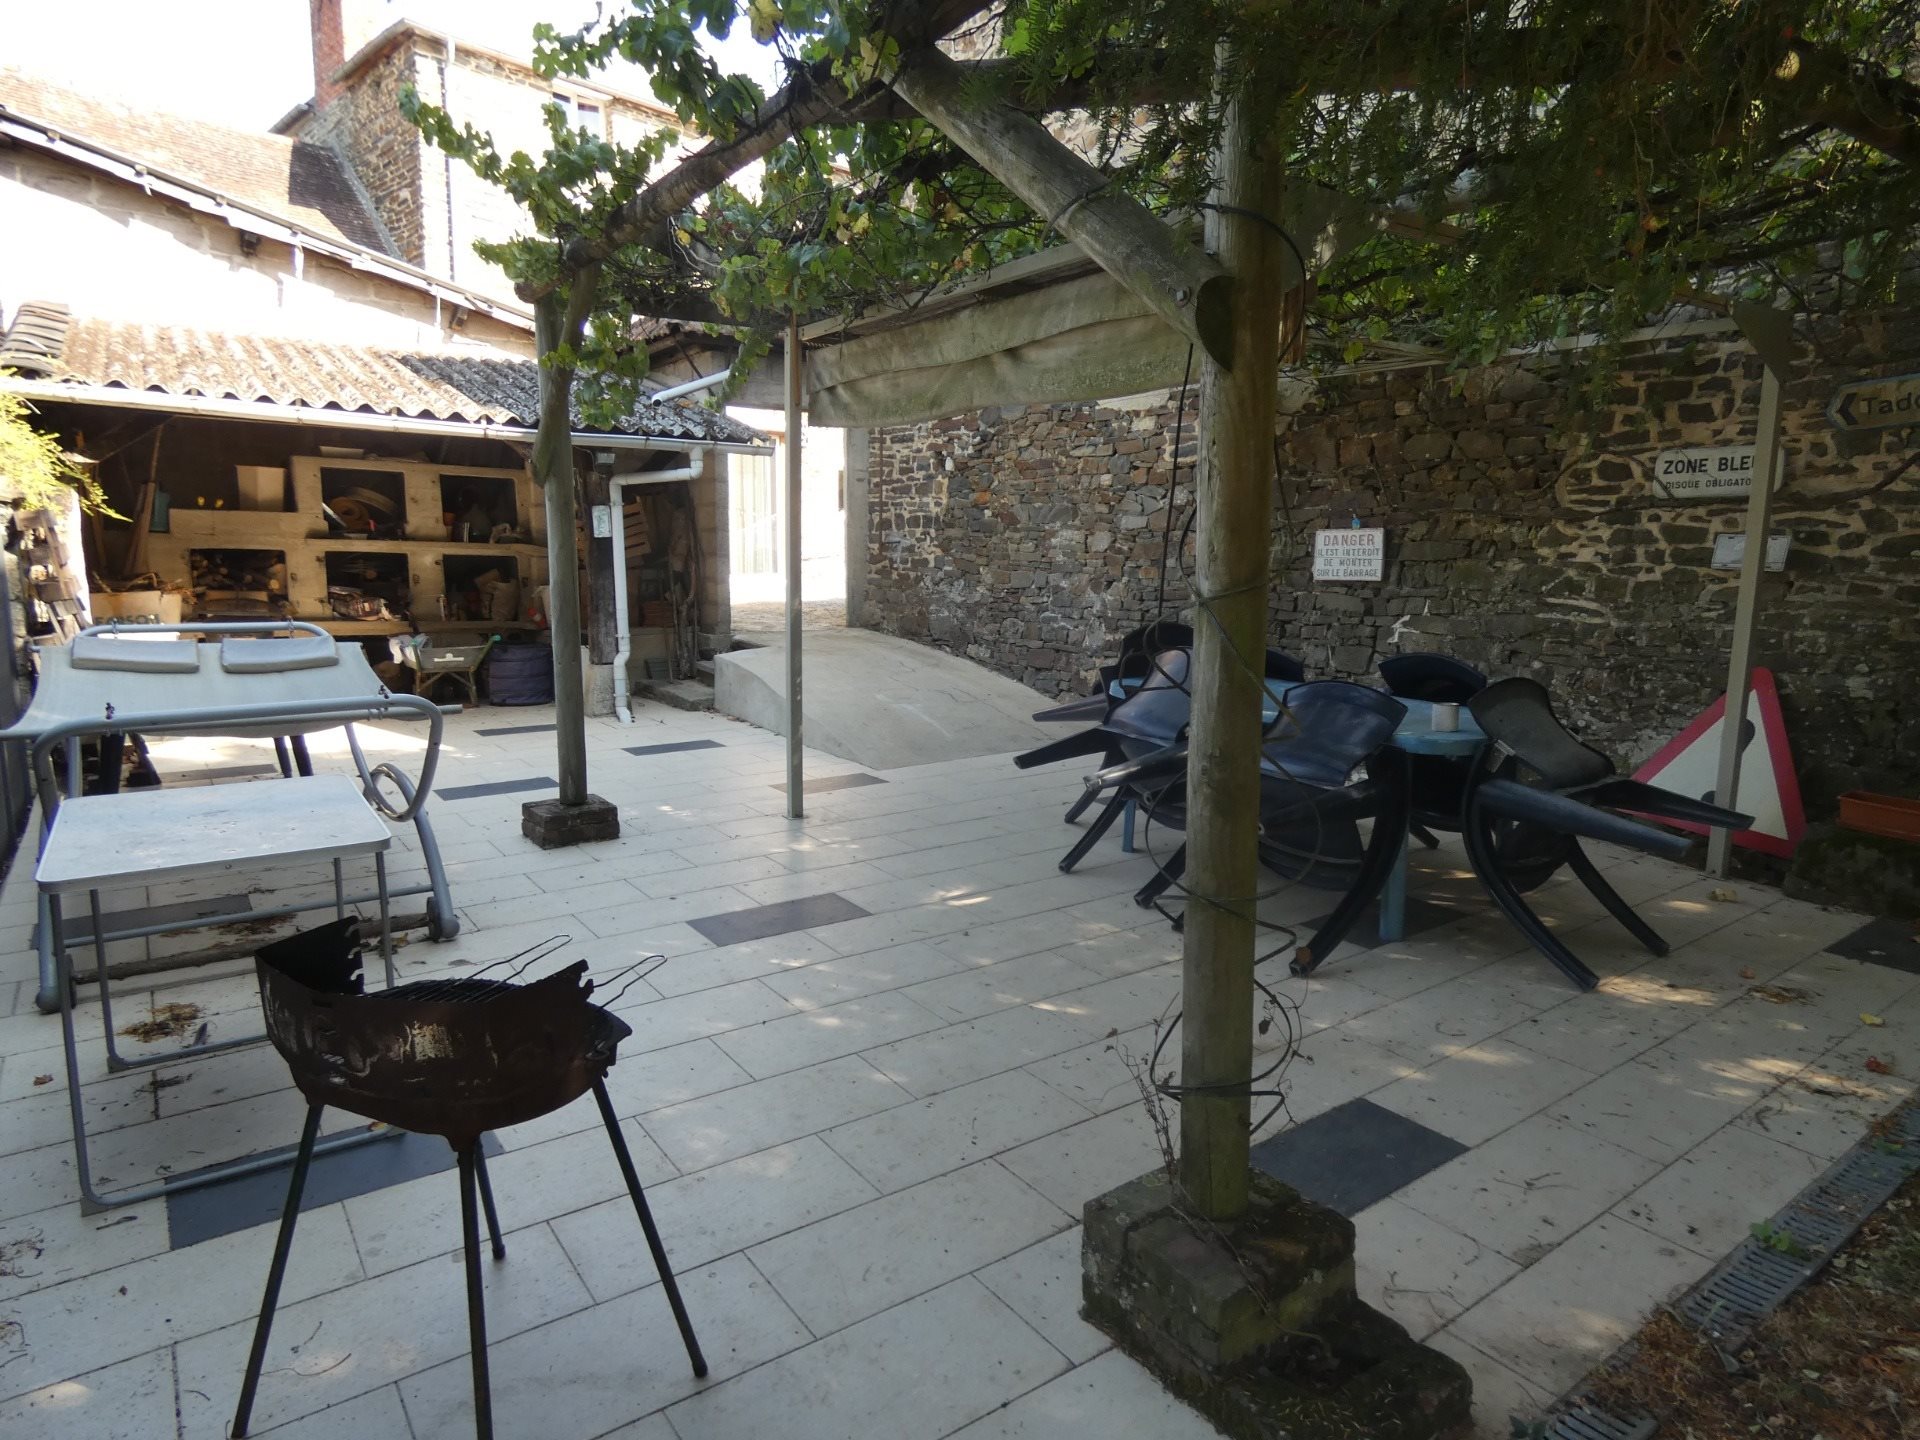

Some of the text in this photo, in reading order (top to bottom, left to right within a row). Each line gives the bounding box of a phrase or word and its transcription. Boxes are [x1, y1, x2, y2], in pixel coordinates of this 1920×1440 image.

[1663, 455, 1755, 475] ZONE BLE
[1665, 478, 1752, 490] DISQUE OBLIGATO
[1323, 533, 1376, 547] DANGER
[1317, 547, 1380, 557] IL EST INTERDIT
[1323, 558, 1373, 567] DE MONTER
[1316, 568, 1379, 578] SUR LE BARRAGE
